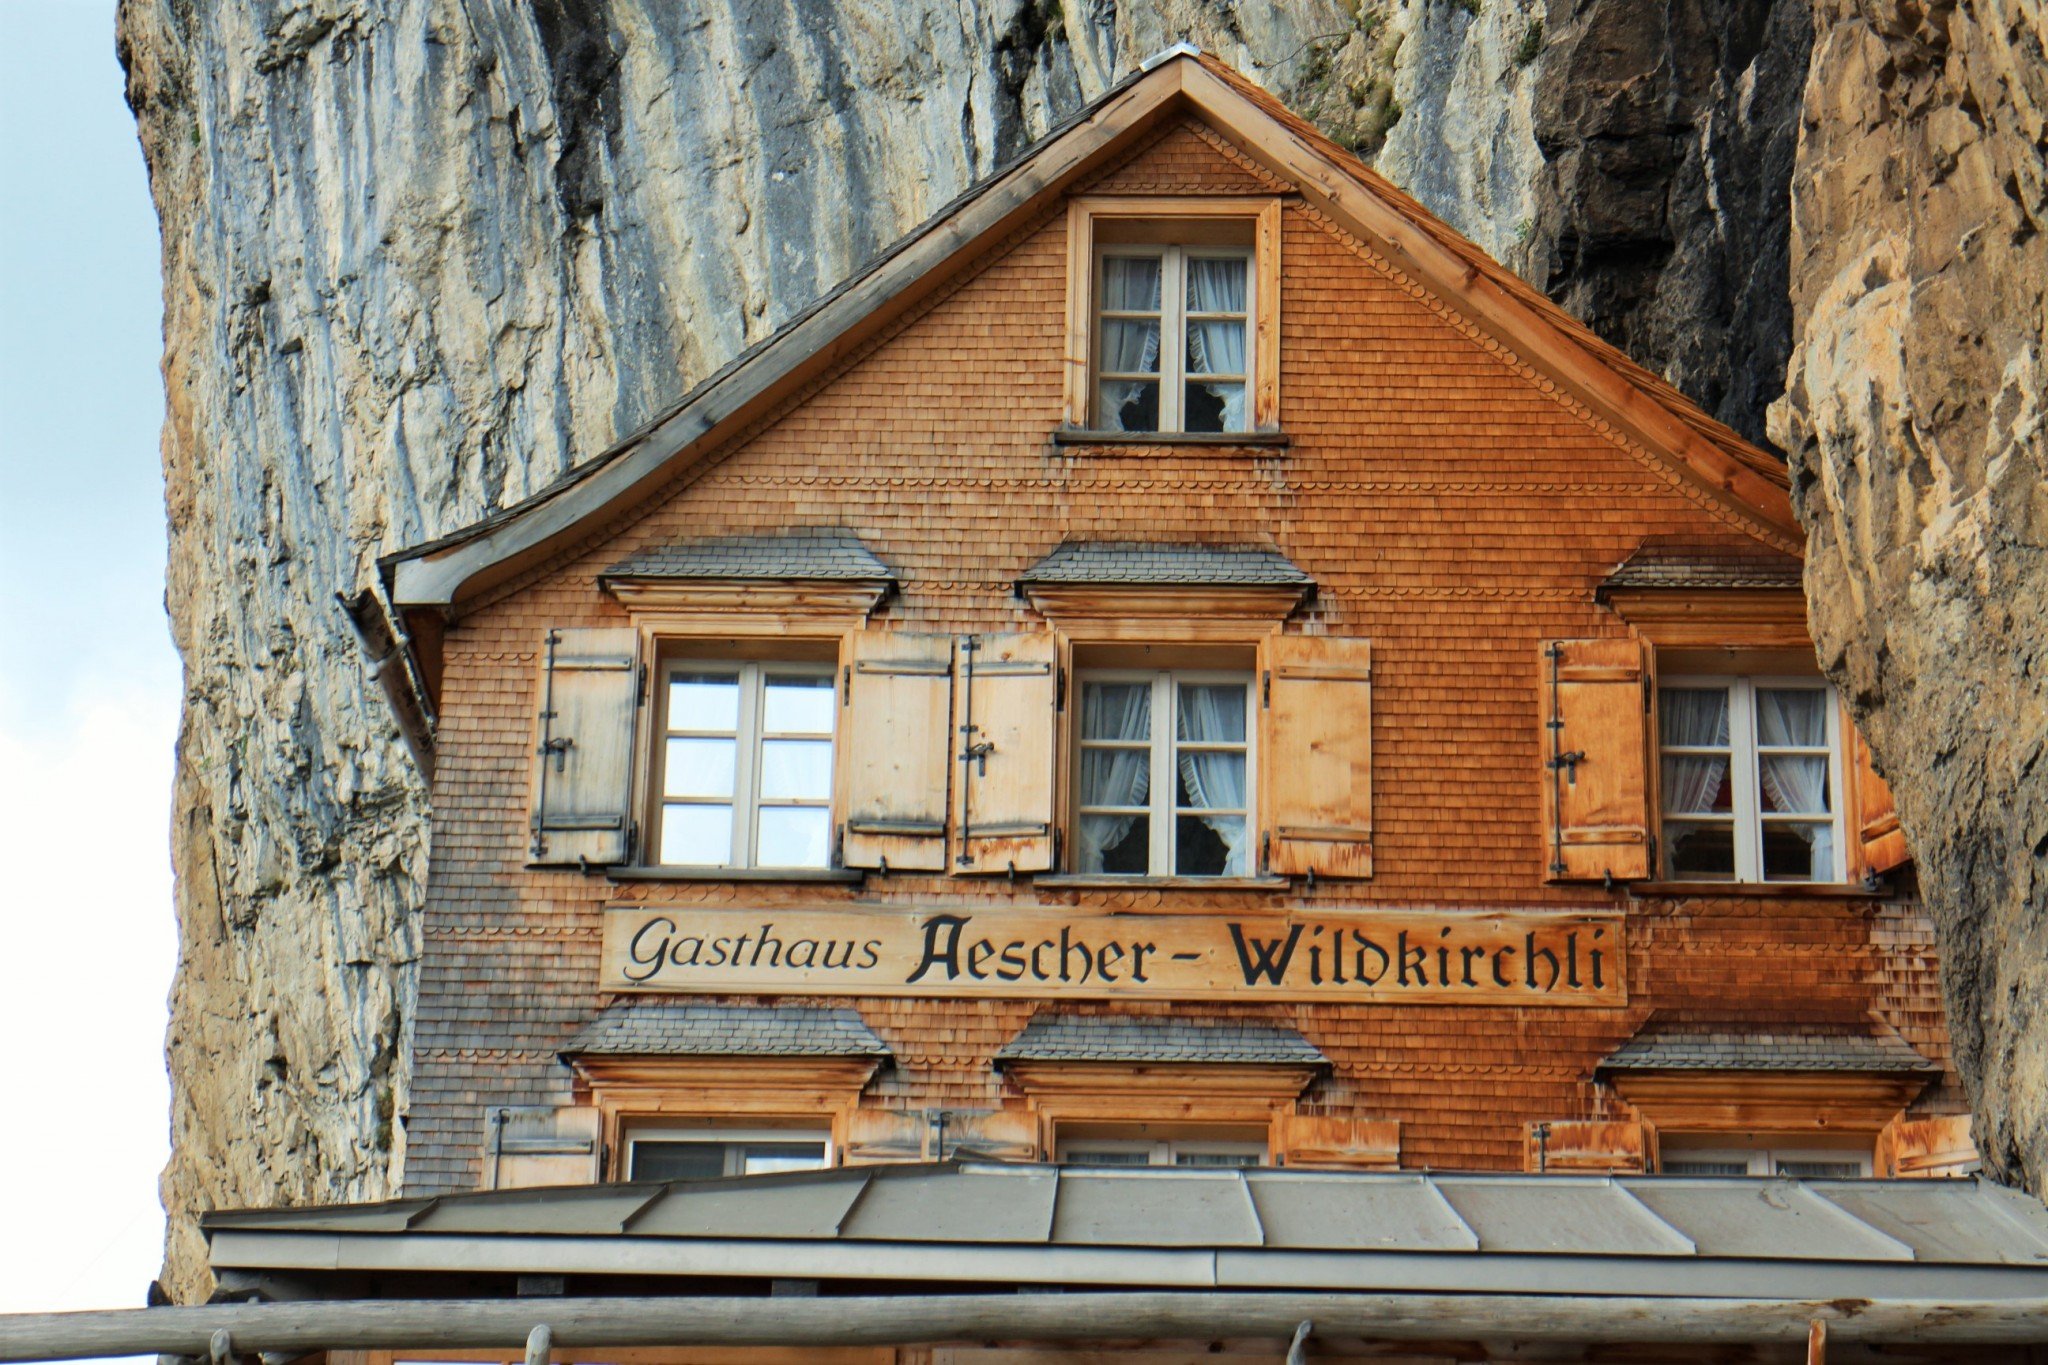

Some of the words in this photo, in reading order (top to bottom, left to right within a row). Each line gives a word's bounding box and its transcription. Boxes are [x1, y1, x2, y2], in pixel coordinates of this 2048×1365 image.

[622, 916, 883, 982] Gasthaus
[905, 913, 1157, 984] Aescher
[1226, 922, 1606, 993] Wildkirchli
